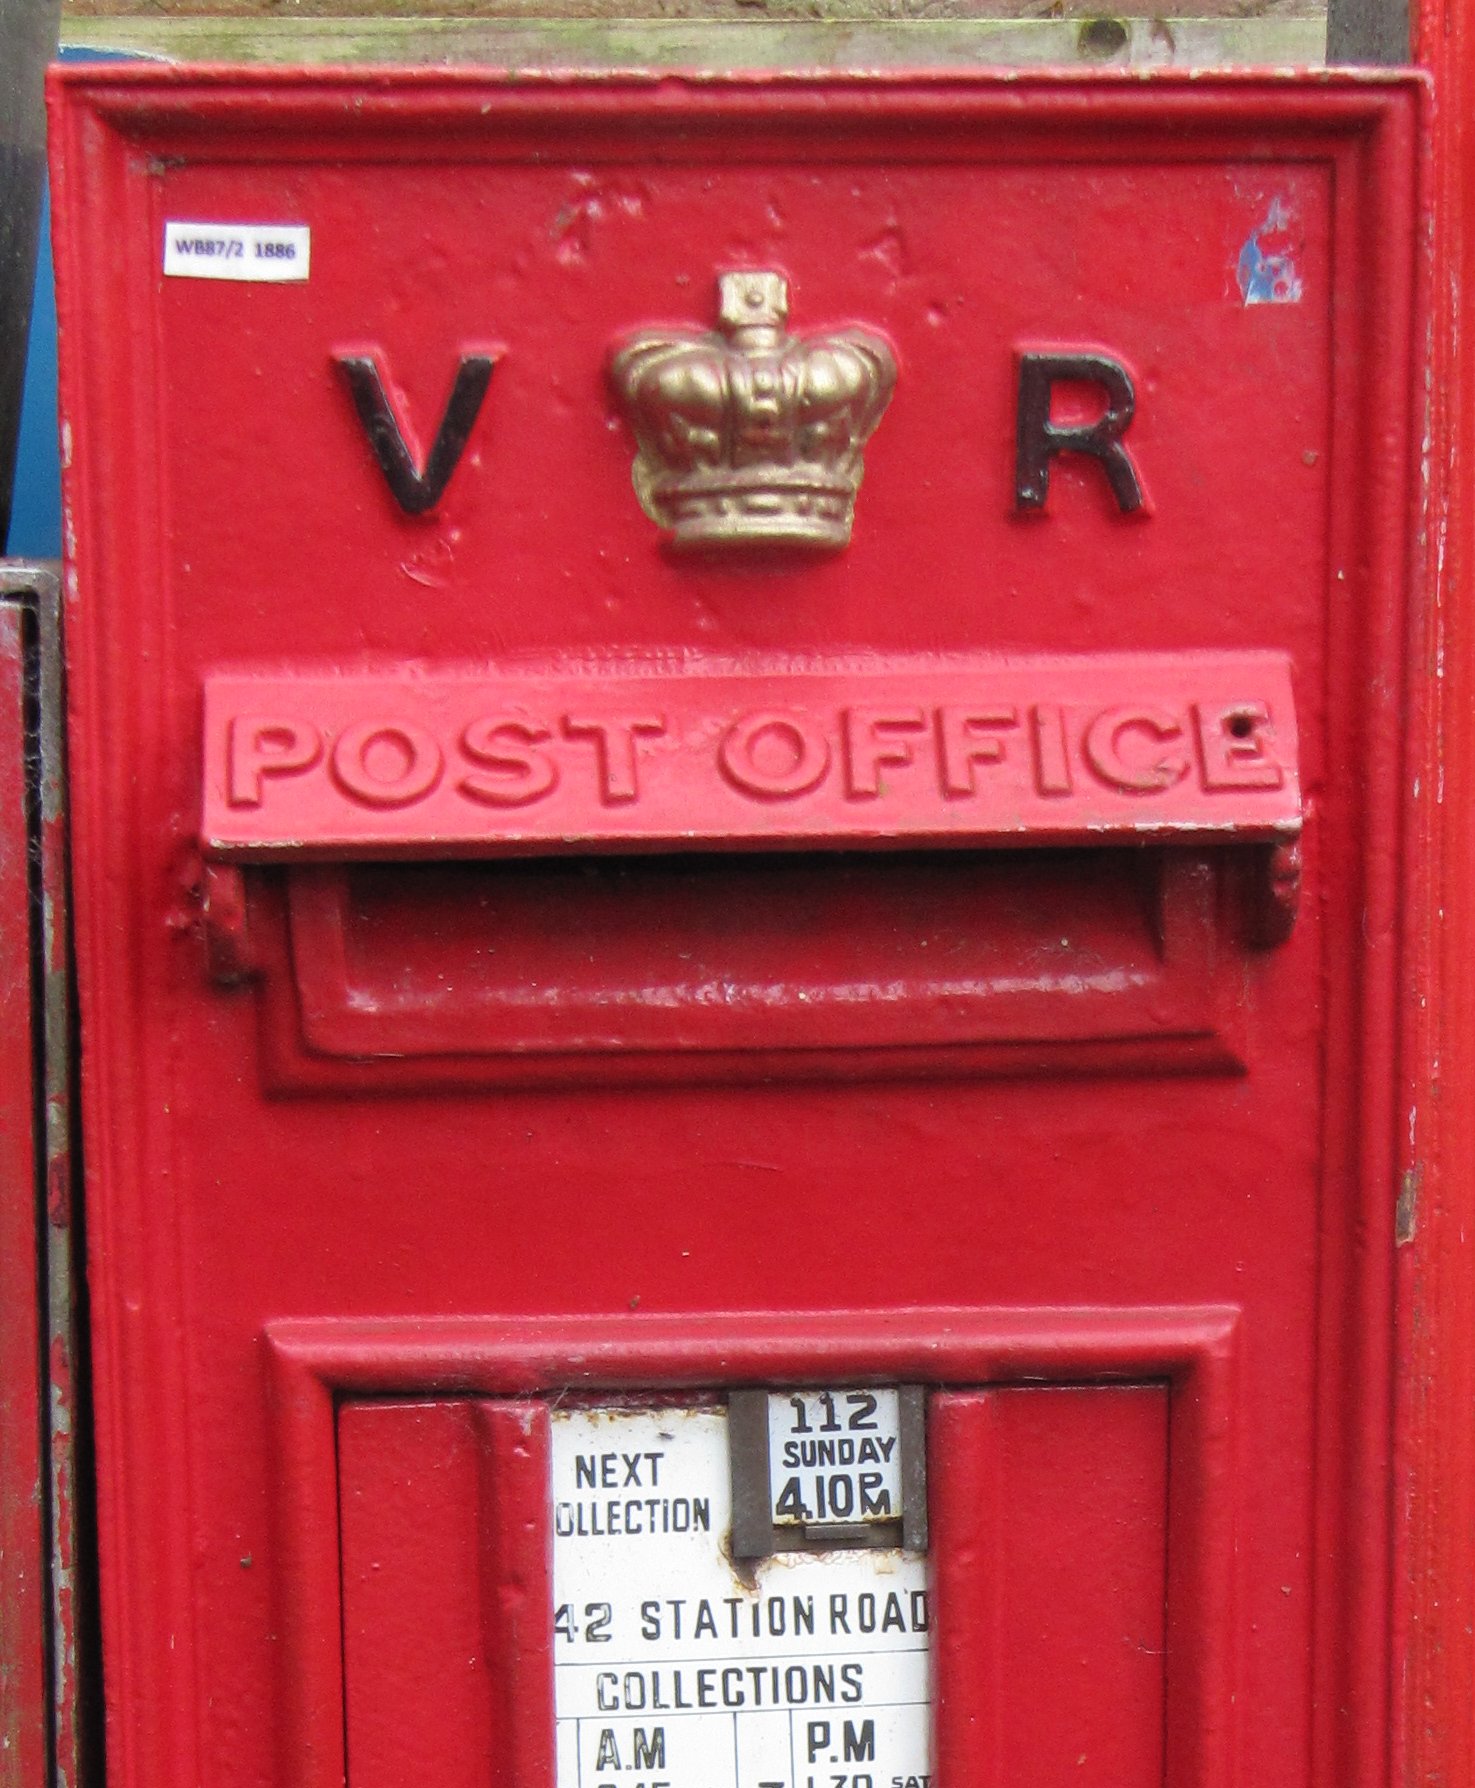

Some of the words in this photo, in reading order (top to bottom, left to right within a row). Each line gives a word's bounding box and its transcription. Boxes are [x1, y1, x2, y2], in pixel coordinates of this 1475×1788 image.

[255, 242, 296, 259] 1886
[332, 349, 504, 516] V
[1014, 346, 1152, 512] R
[226, 713, 668, 812] POST
[716, 701, 1286, 804] OFFICE
[790, 1392, 879, 1434] 112
[575, 1452, 664, 1490] NEXT
[783, 1436, 897, 1468] SUNDAY
[554, 1602, 613, 1644] 42
[641, 1594, 815, 1642] STATION
[830, 1590, 930, 1635] ROAD
[596, 1663, 864, 1712] COLLECTIONS
[595, 1727, 667, 1772] A.M
[807, 1719, 876, 1765] P.M
